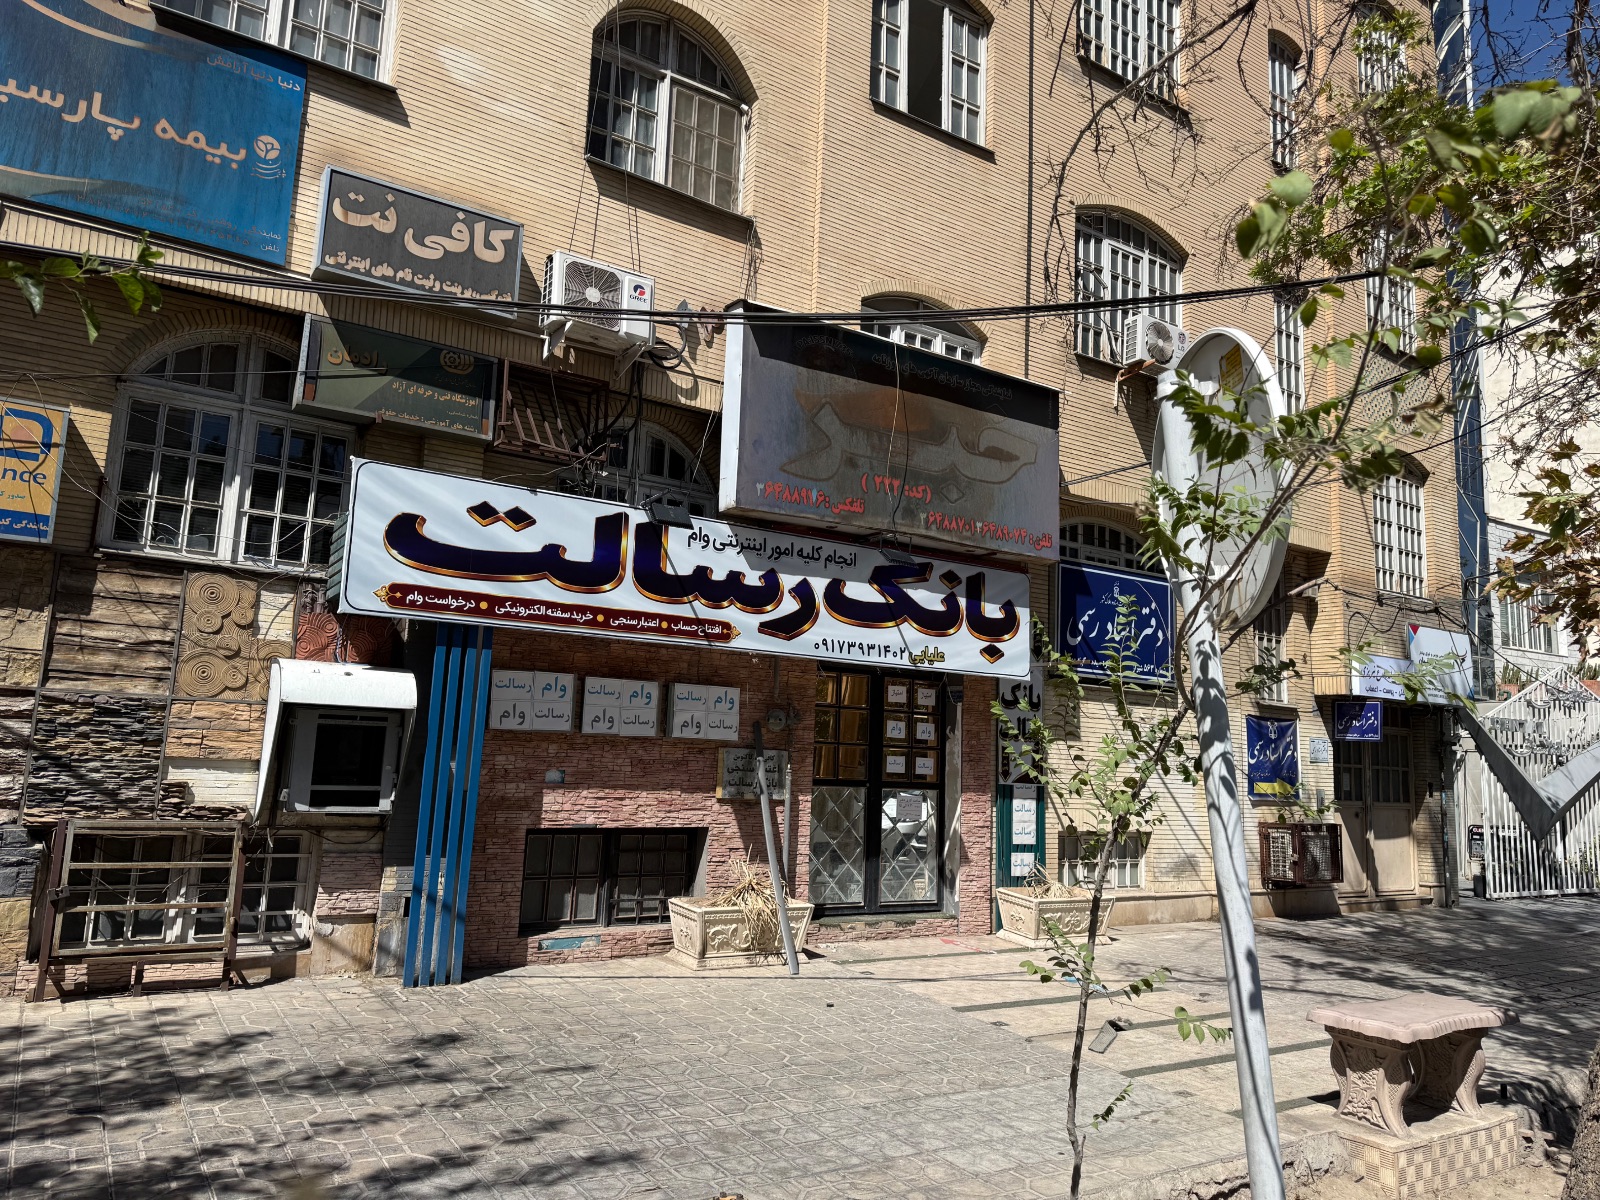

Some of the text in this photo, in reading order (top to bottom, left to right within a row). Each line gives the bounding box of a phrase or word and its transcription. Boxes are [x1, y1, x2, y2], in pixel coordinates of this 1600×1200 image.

[206, 55, 301, 91] دنیا دنیا آرامش
[153, 118, 247, 170] بیمه
[332, 192, 515, 263] کافی نت
[260, 243, 280, 253] تلفن
[371, 262, 394, 277] های
[396, 267, 413, 282] نام
[414, 273, 434, 289] ثبت
[392, 381, 406, 393] آزاد
[417, 385, 433, 398] حرفه
[439, 391, 451, 401] فنی
[687, 526, 857, 569] انجام کلیه امور اینترنتی وام
[383, 500, 1021, 664] بانک رسالت
[406, 590, 423, 604] وام
[425, 594, 476, 610] درخواست
[495, 601, 546, 617] الکترونیکی
[546, 606, 570, 618] سفته
[571, 610, 593, 623] خرید
[671, 621, 698, 631] حساب
[697, 622, 722, 635] افتتاح
[1067, 607, 1099, 646] رسمی
[1130, 601, 1163, 652] دفتر
[814, 638, 906, 660] ۰۹۱۷۳۹۳۱۴۰۲
[494, 677, 532, 693] رسالت
[541, 676, 567, 699] وام
[587, 684, 621, 700] رسالت
[629, 683, 652, 705] وام
[676, 690, 707, 705] رسالت
[714, 690, 735, 711] وام
[500, 703, 526, 725] وام
[534, 708, 571, 723] رسالت
[591, 708, 615, 730] وام
[623, 714, 655, 729] رسالت
[680, 714, 702, 735] وام
[709, 719, 738, 733] رسالت
[891, 723, 902, 734] وام
[921, 727, 932, 738] وام
[1249, 736, 1297, 765] دفتر اسناد رسمی
[917, 763, 932, 771] رسالت
[728, 777, 758, 789] رسالت
[1014, 803, 1036, 815] رسالت
[1014, 826, 1036, 838] رسالت
